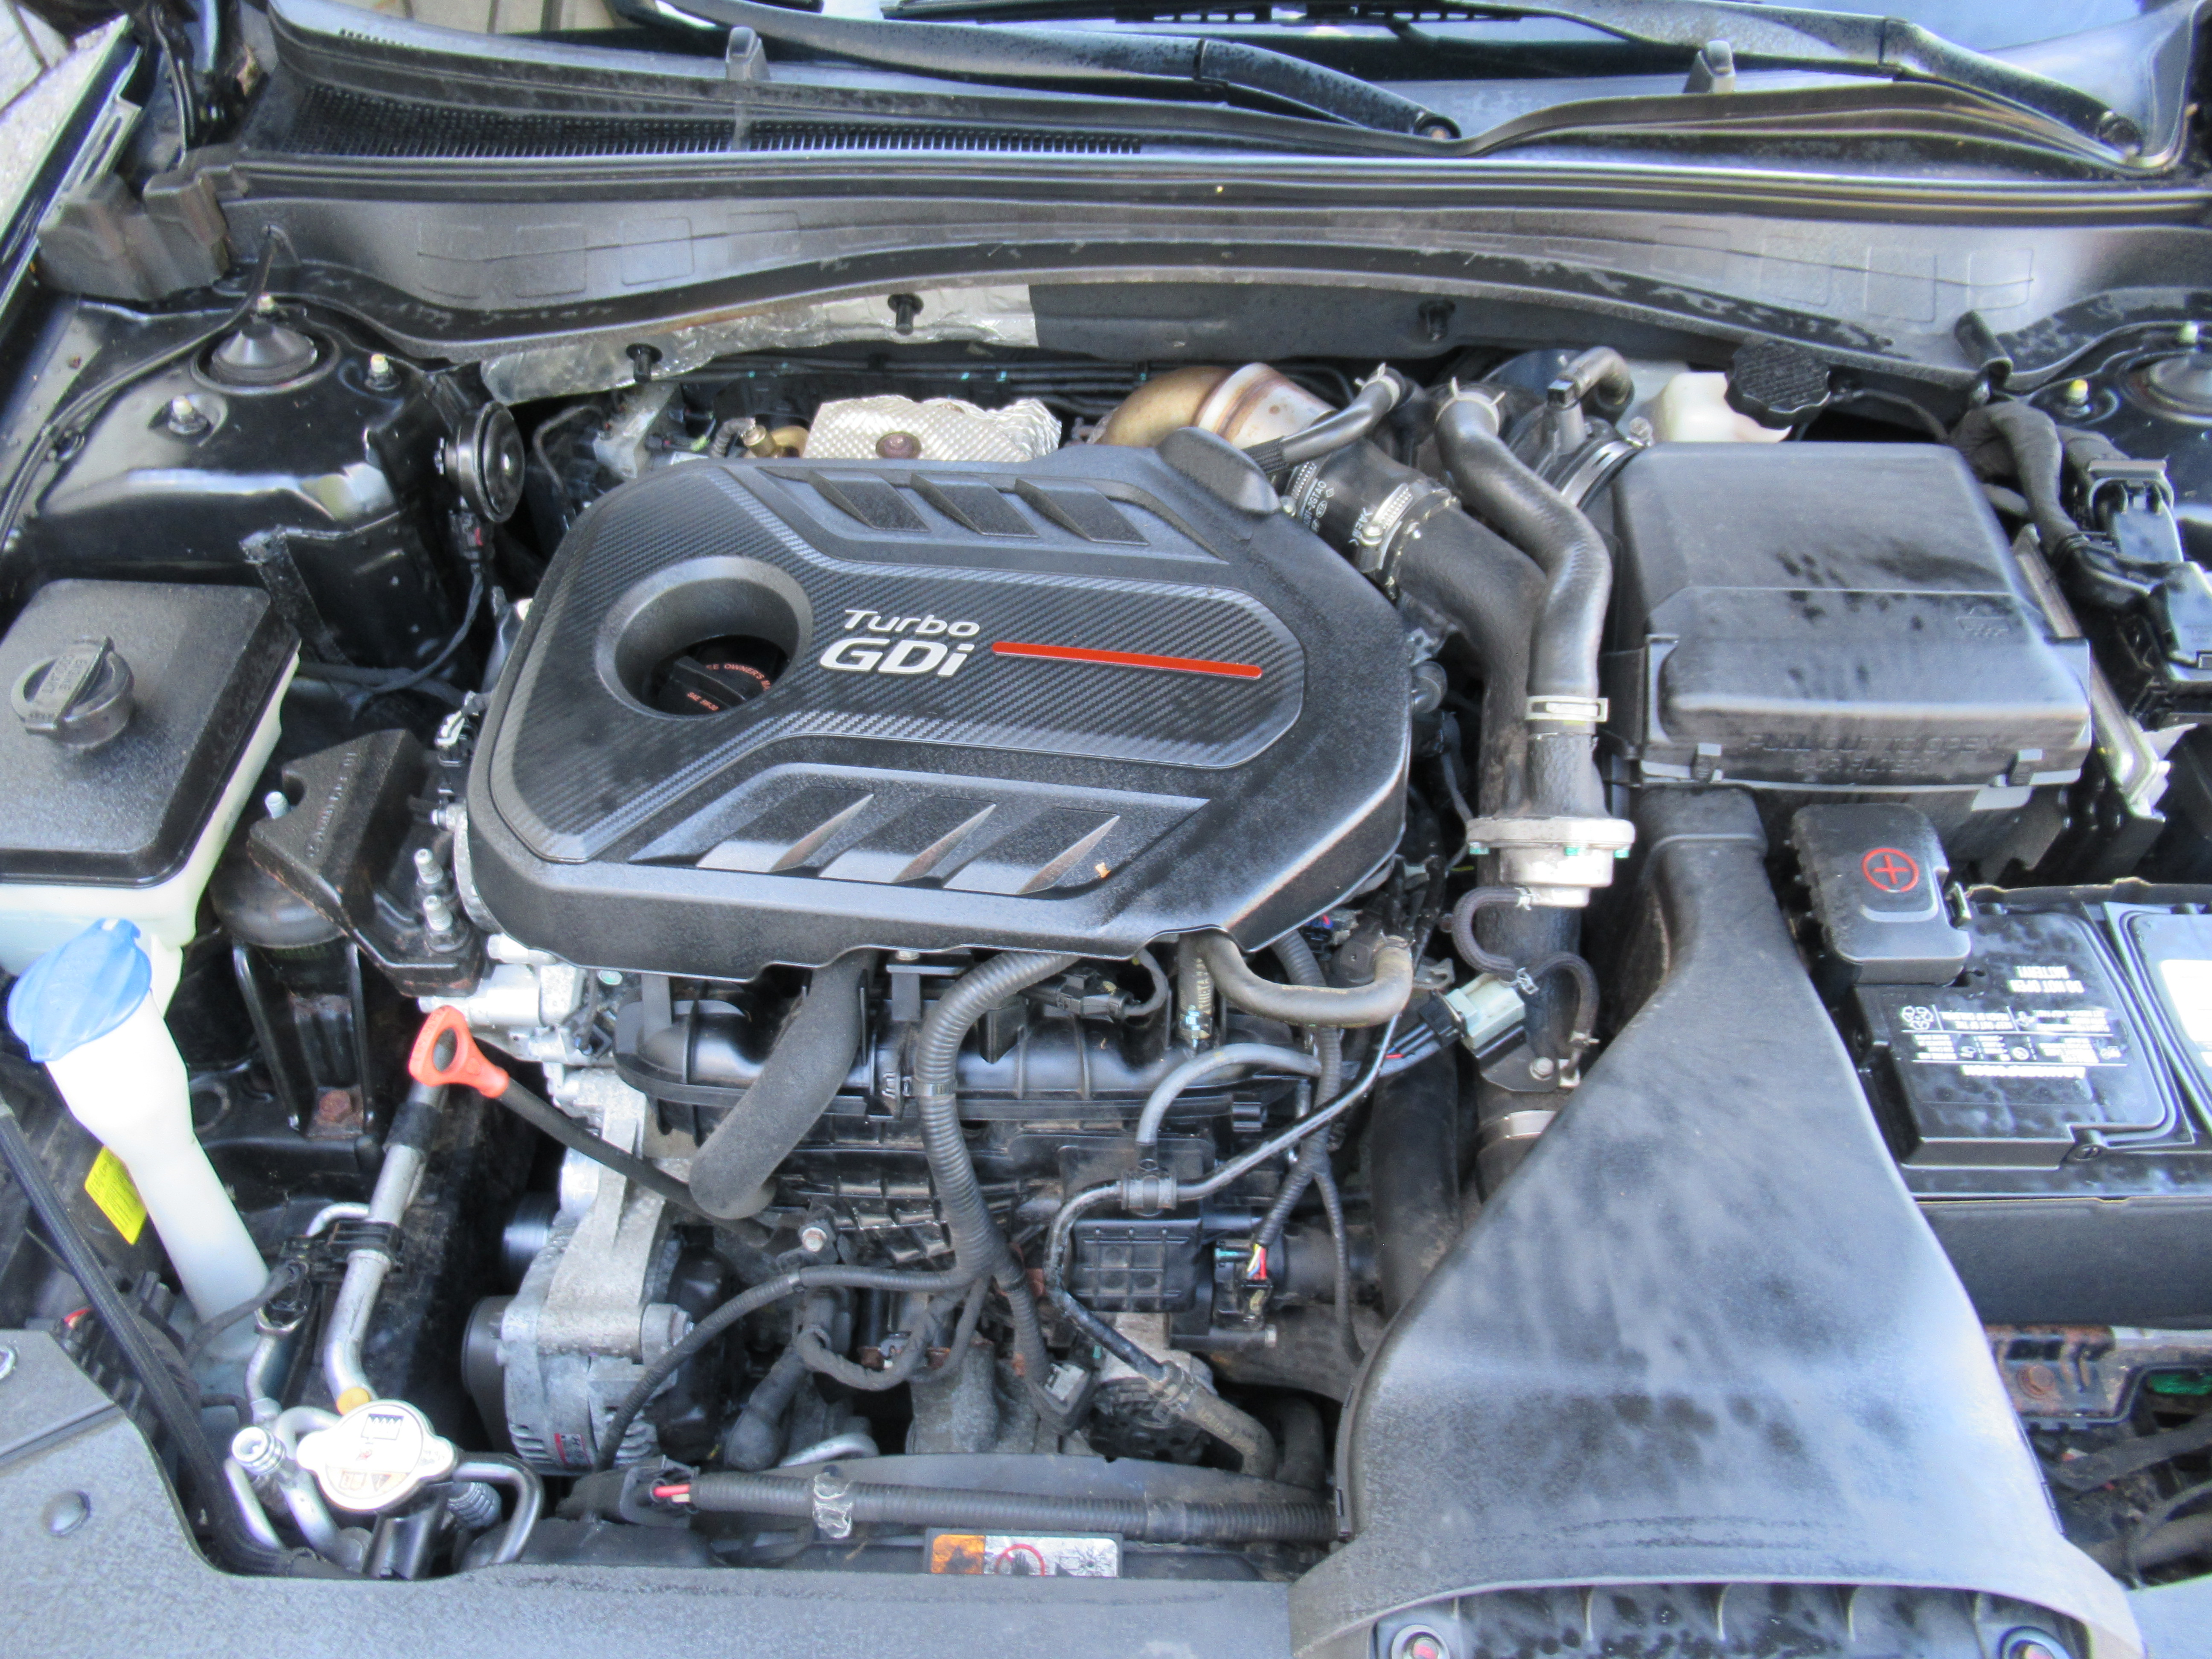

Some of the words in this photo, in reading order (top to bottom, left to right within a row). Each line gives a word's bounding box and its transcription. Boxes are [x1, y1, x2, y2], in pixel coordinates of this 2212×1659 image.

[844, 609, 980, 639] Turbo
[820, 637, 974, 677] GDi
[2017, 966, 2069, 978] BATTERY!
[2010, 980, 2041, 992] OPEN
[2042, 981, 2065, 992] NOT
[2066, 981, 2084, 992] DO
